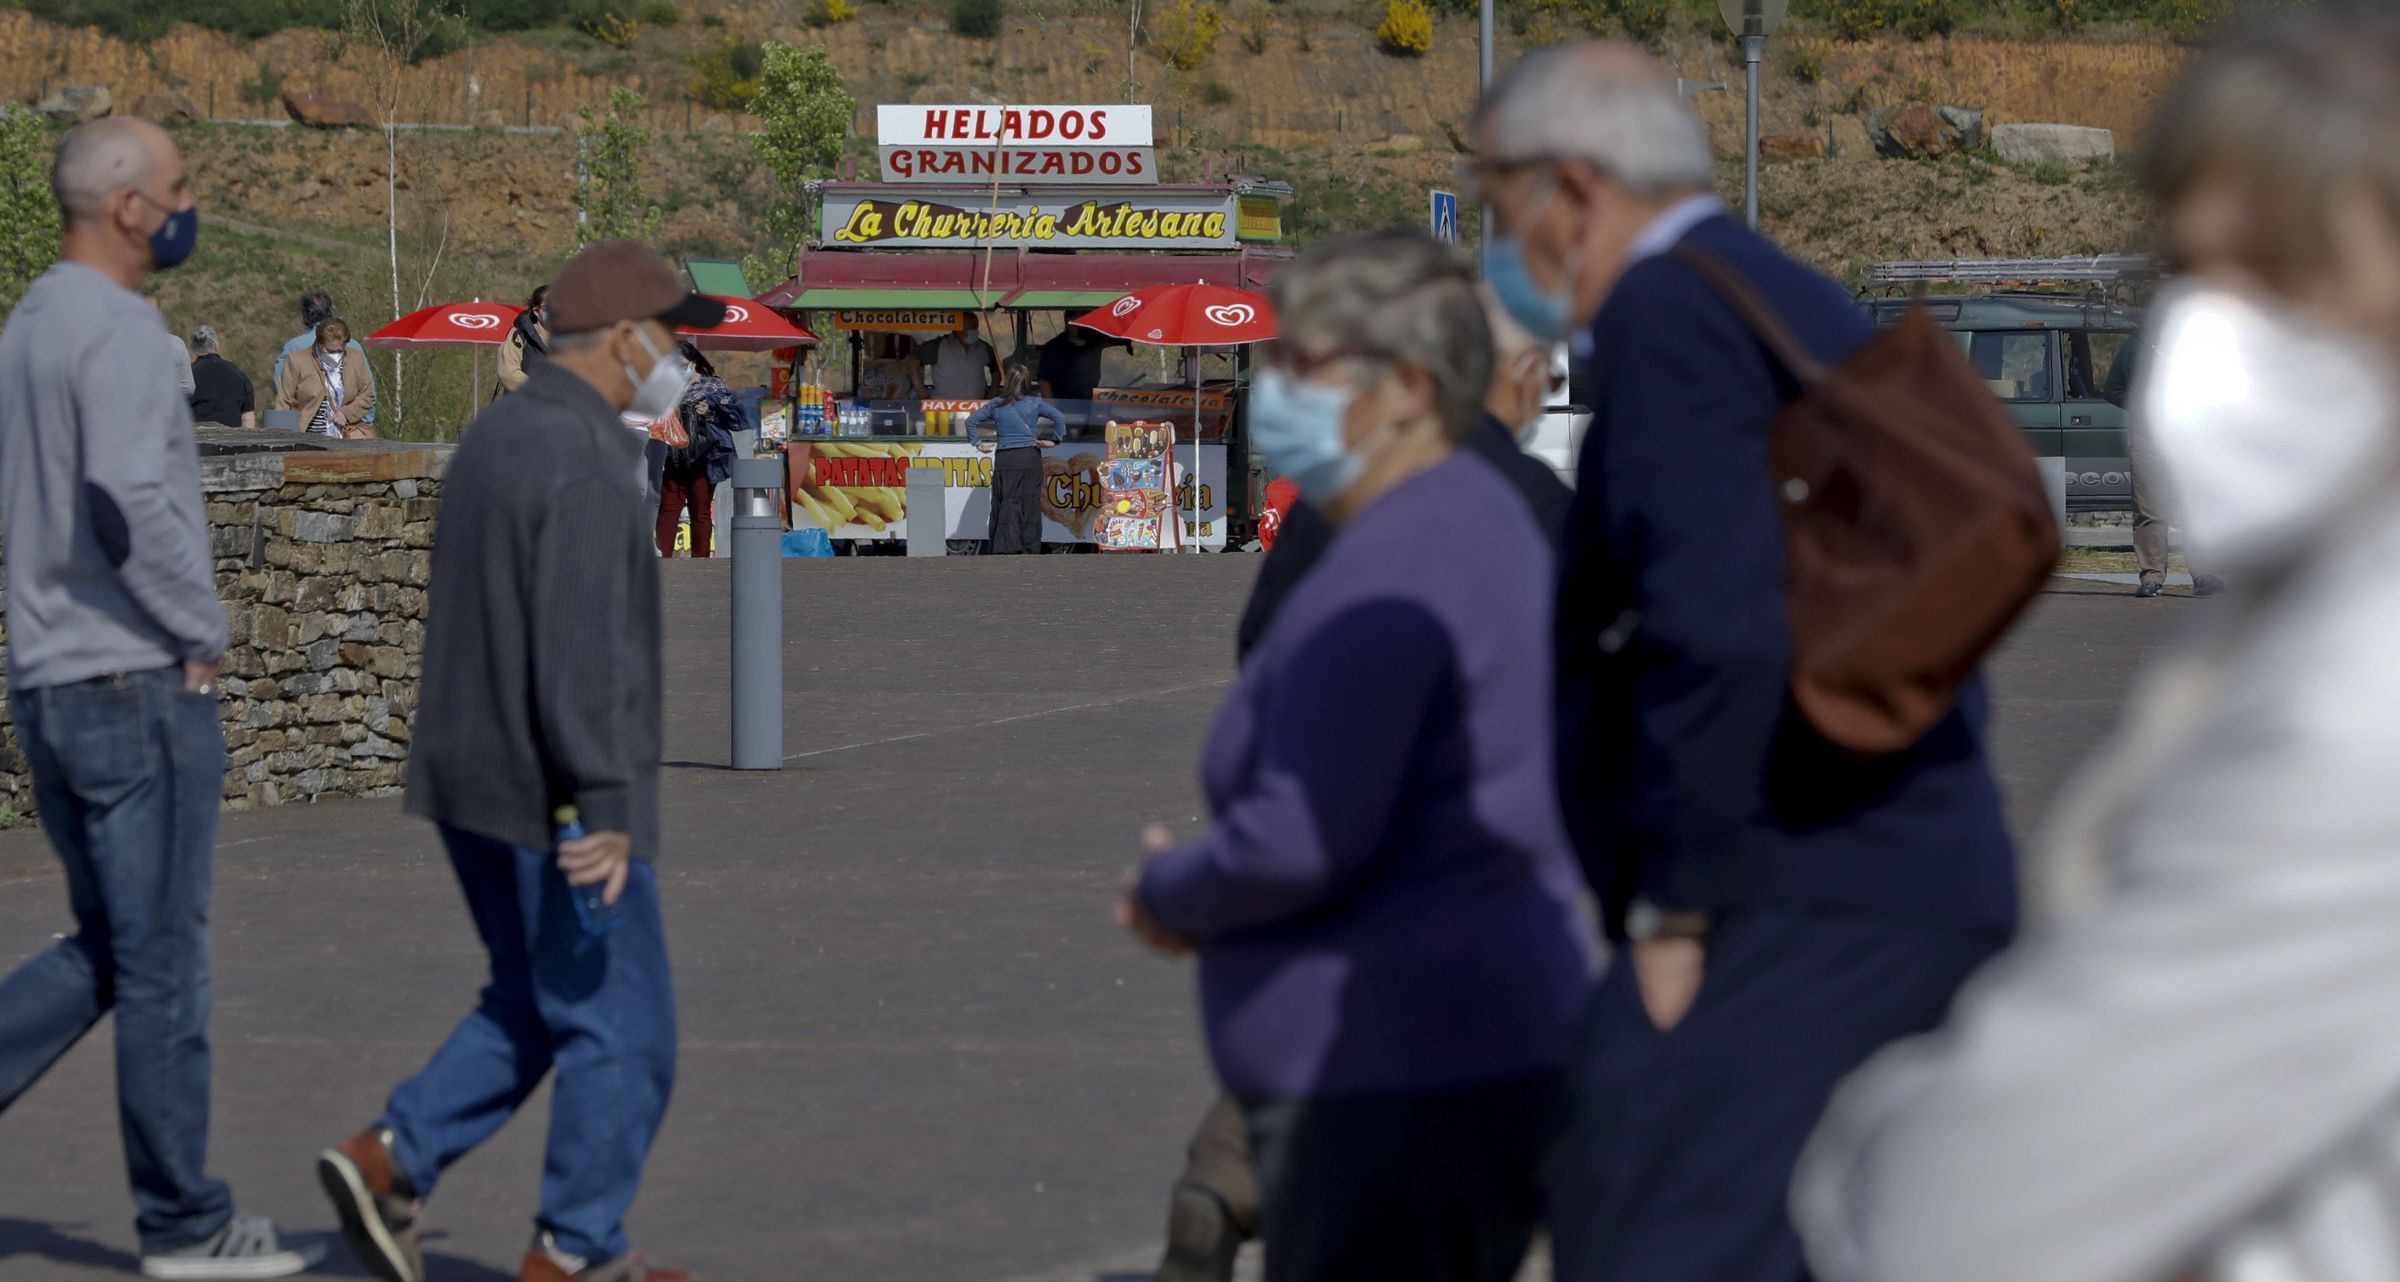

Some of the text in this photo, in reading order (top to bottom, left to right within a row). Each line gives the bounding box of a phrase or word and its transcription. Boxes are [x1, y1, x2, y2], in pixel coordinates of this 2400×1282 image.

[923, 109, 1107, 140] HELADOS
[889, 149, 1143, 178] GRANIZADOS
[834, 199, 883, 244] La
[893, 199, 1056, 240] Churreria
[1066, 200, 1226, 239] Artesana
[921, 401, 957, 411] HAY
[814, 456, 910, 488] PATATAS
